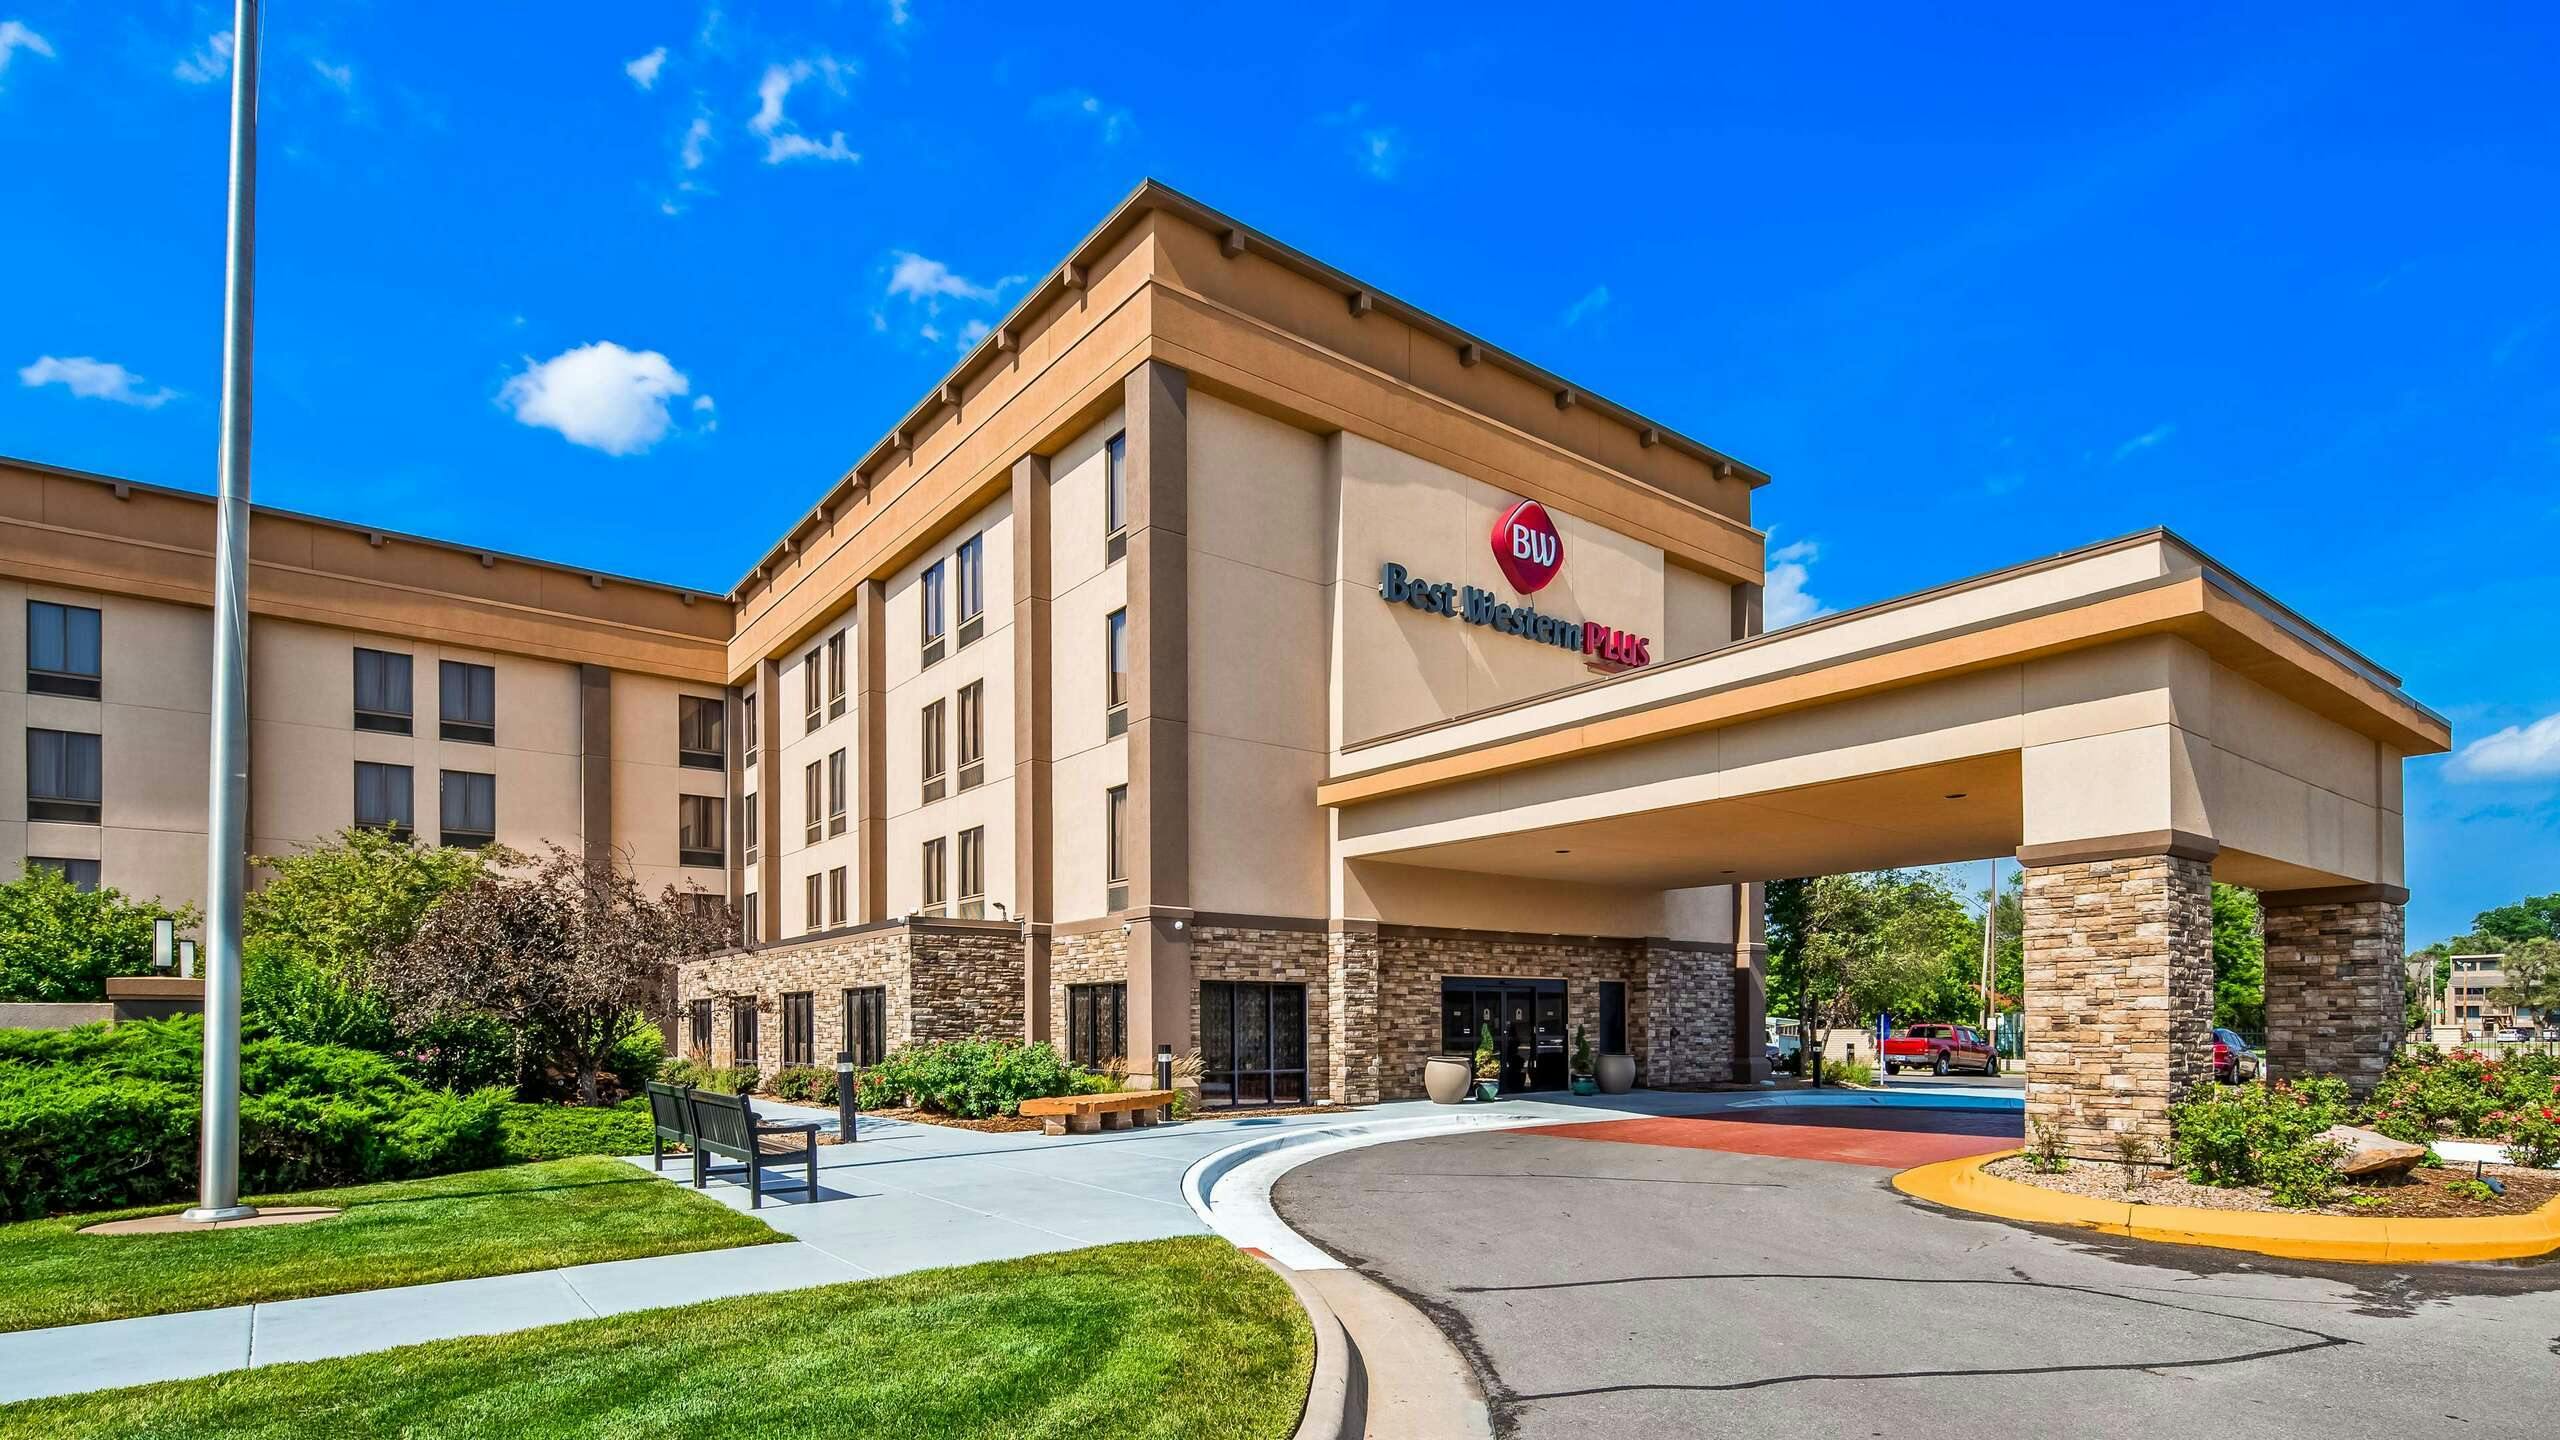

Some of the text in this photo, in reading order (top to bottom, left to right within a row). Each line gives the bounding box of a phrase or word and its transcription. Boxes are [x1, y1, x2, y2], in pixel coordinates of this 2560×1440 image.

[1513, 523, 1556, 567] BW
[1382, 562, 1650, 668] Best Western PLUS
